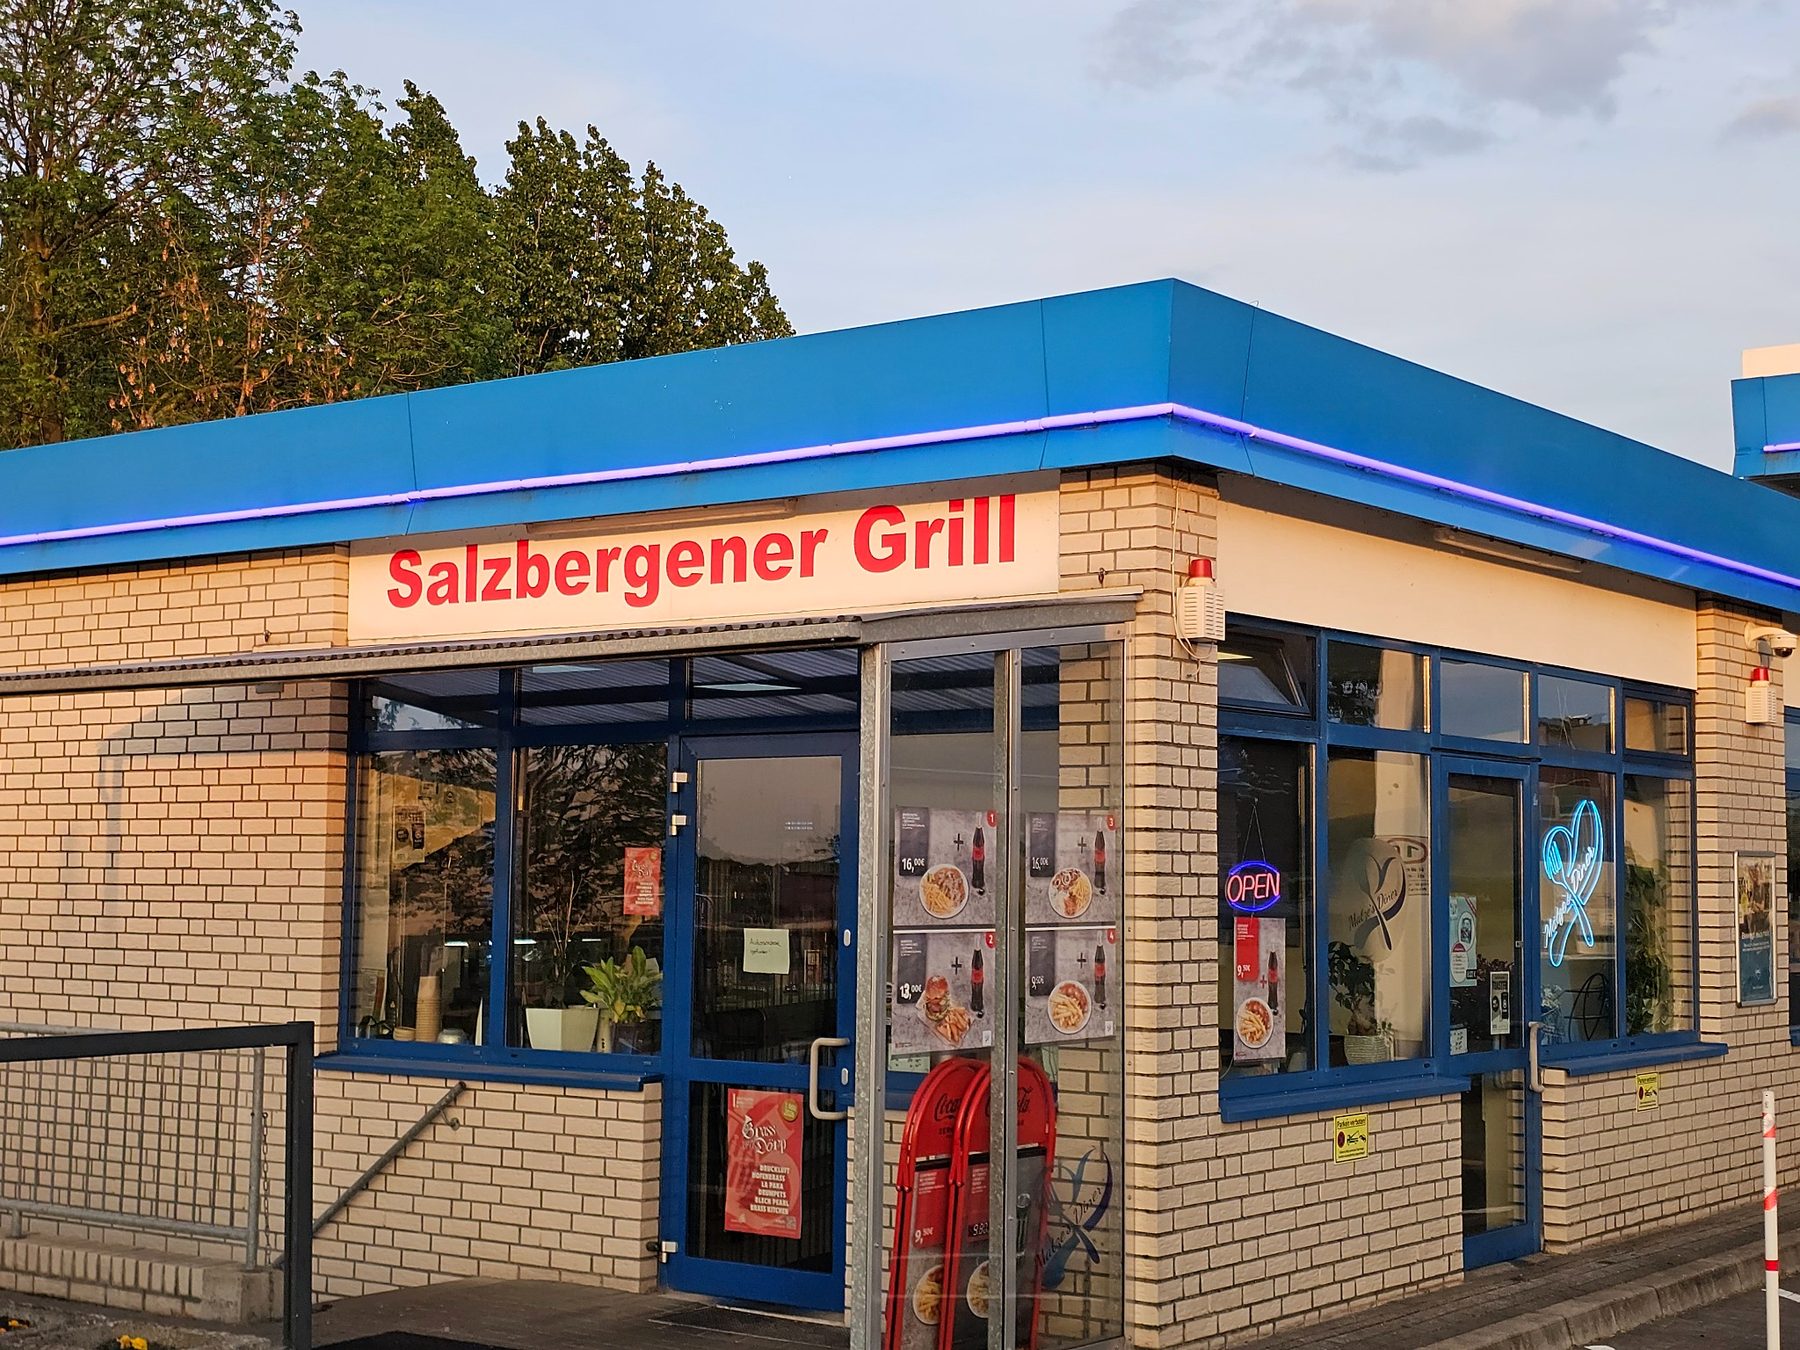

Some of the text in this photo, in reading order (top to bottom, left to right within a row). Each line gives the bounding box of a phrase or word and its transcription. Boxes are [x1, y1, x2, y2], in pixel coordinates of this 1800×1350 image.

[387, 493, 1017, 608] Salzbergener Grill
[1227, 872, 1280, 903] OPEN
